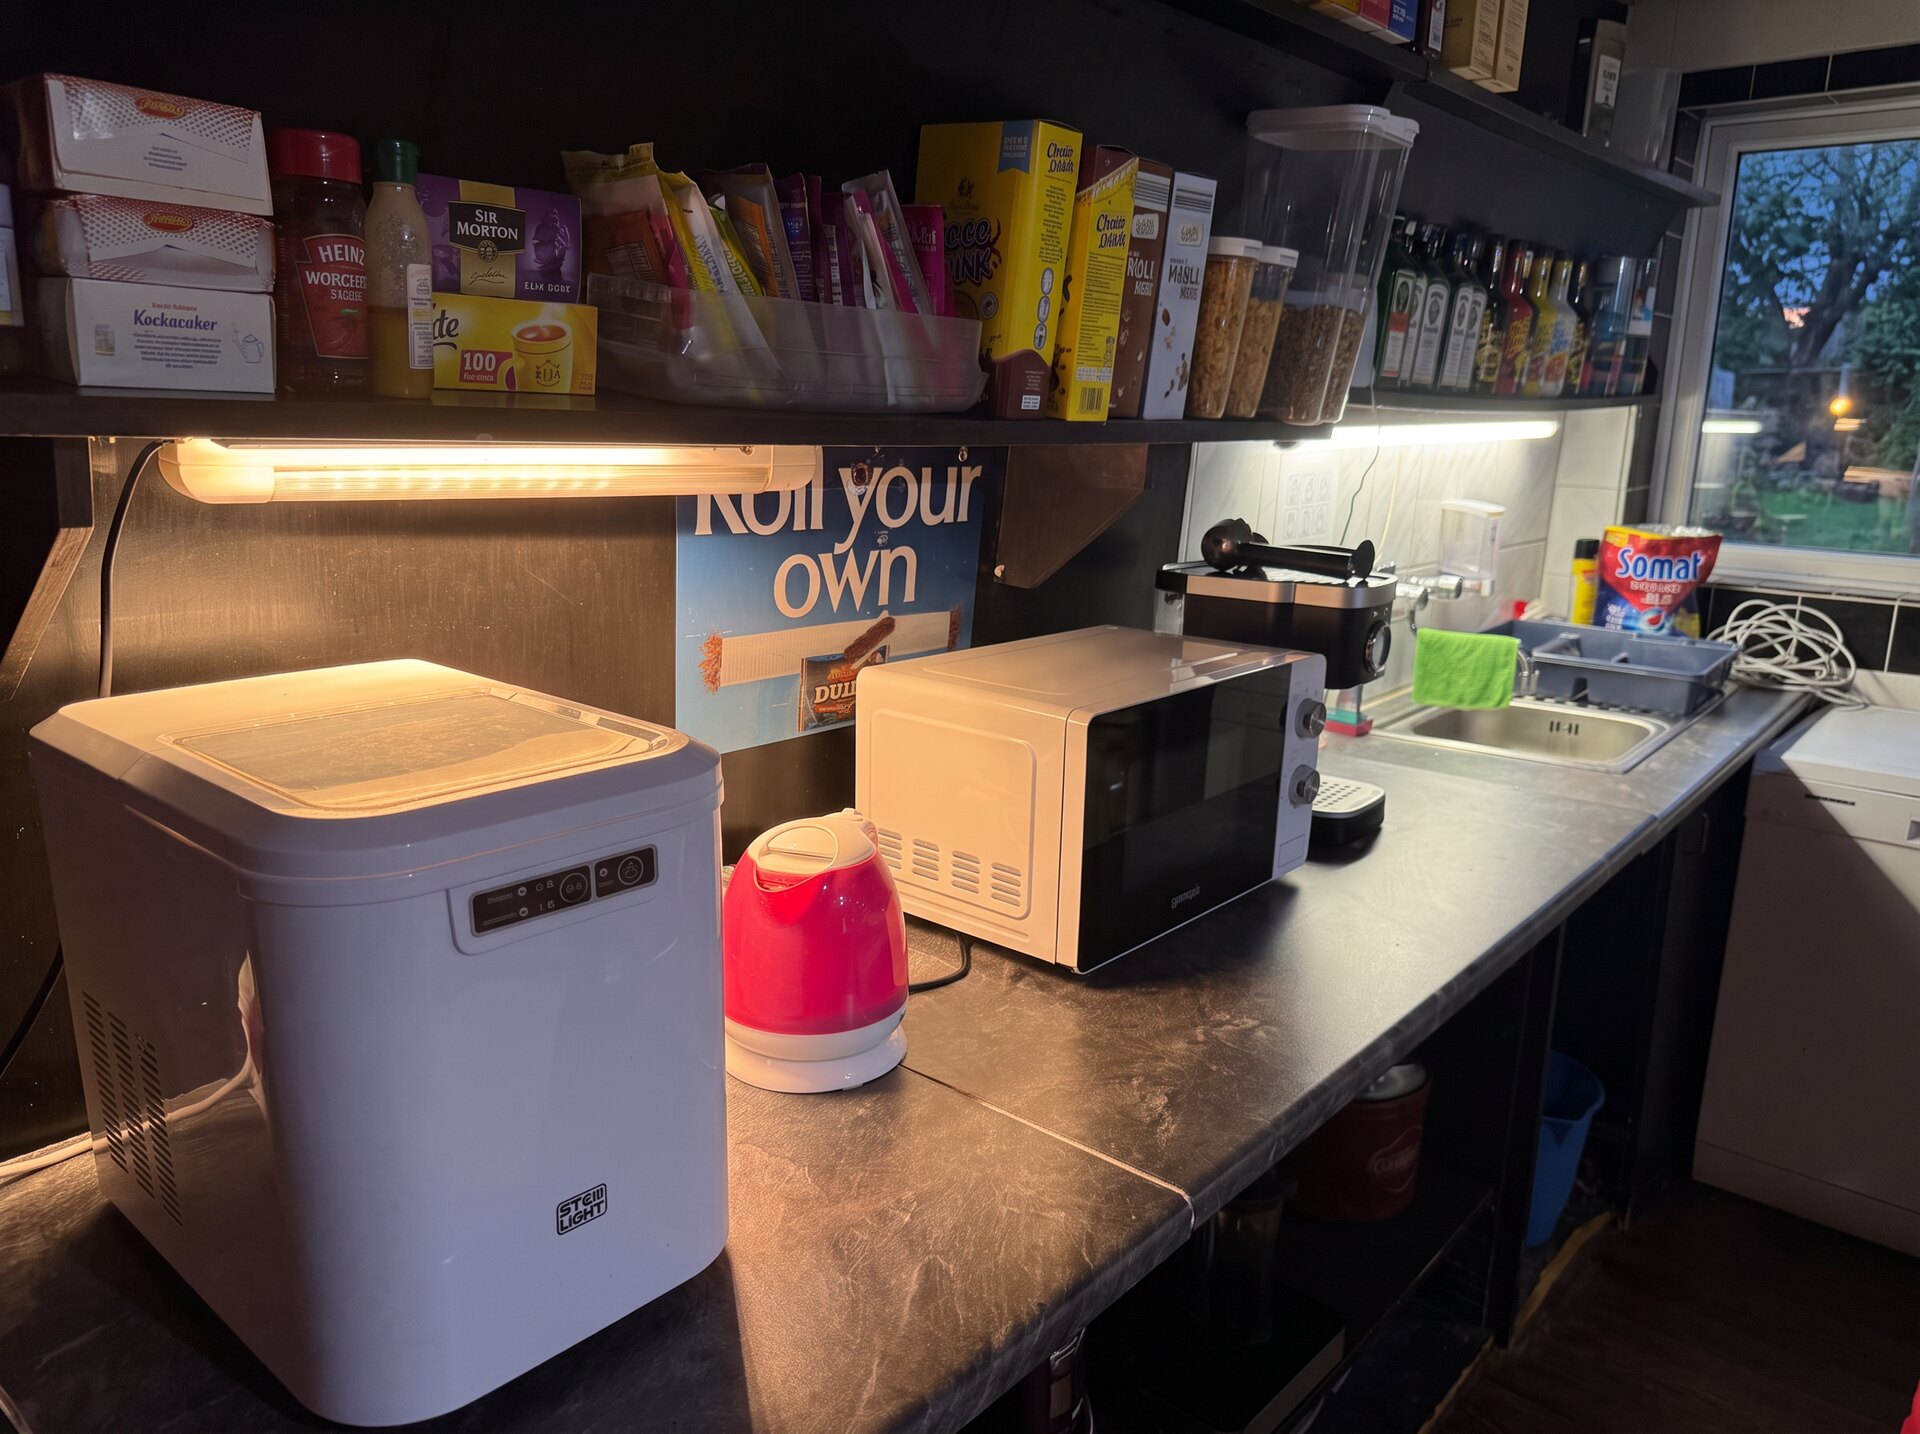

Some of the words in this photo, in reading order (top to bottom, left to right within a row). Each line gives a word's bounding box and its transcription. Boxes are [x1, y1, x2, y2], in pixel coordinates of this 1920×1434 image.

[475, 208, 498, 224] SIR
[456, 221, 518, 240] MORTON
[318, 244, 365, 266] HEINZ
[134, 309, 218, 331] Kockacaker
[463, 352, 496, 372] 100
[833, 465, 982, 555] your
[1616, 548, 1702, 581] Somat
[773, 545, 917, 619] own
